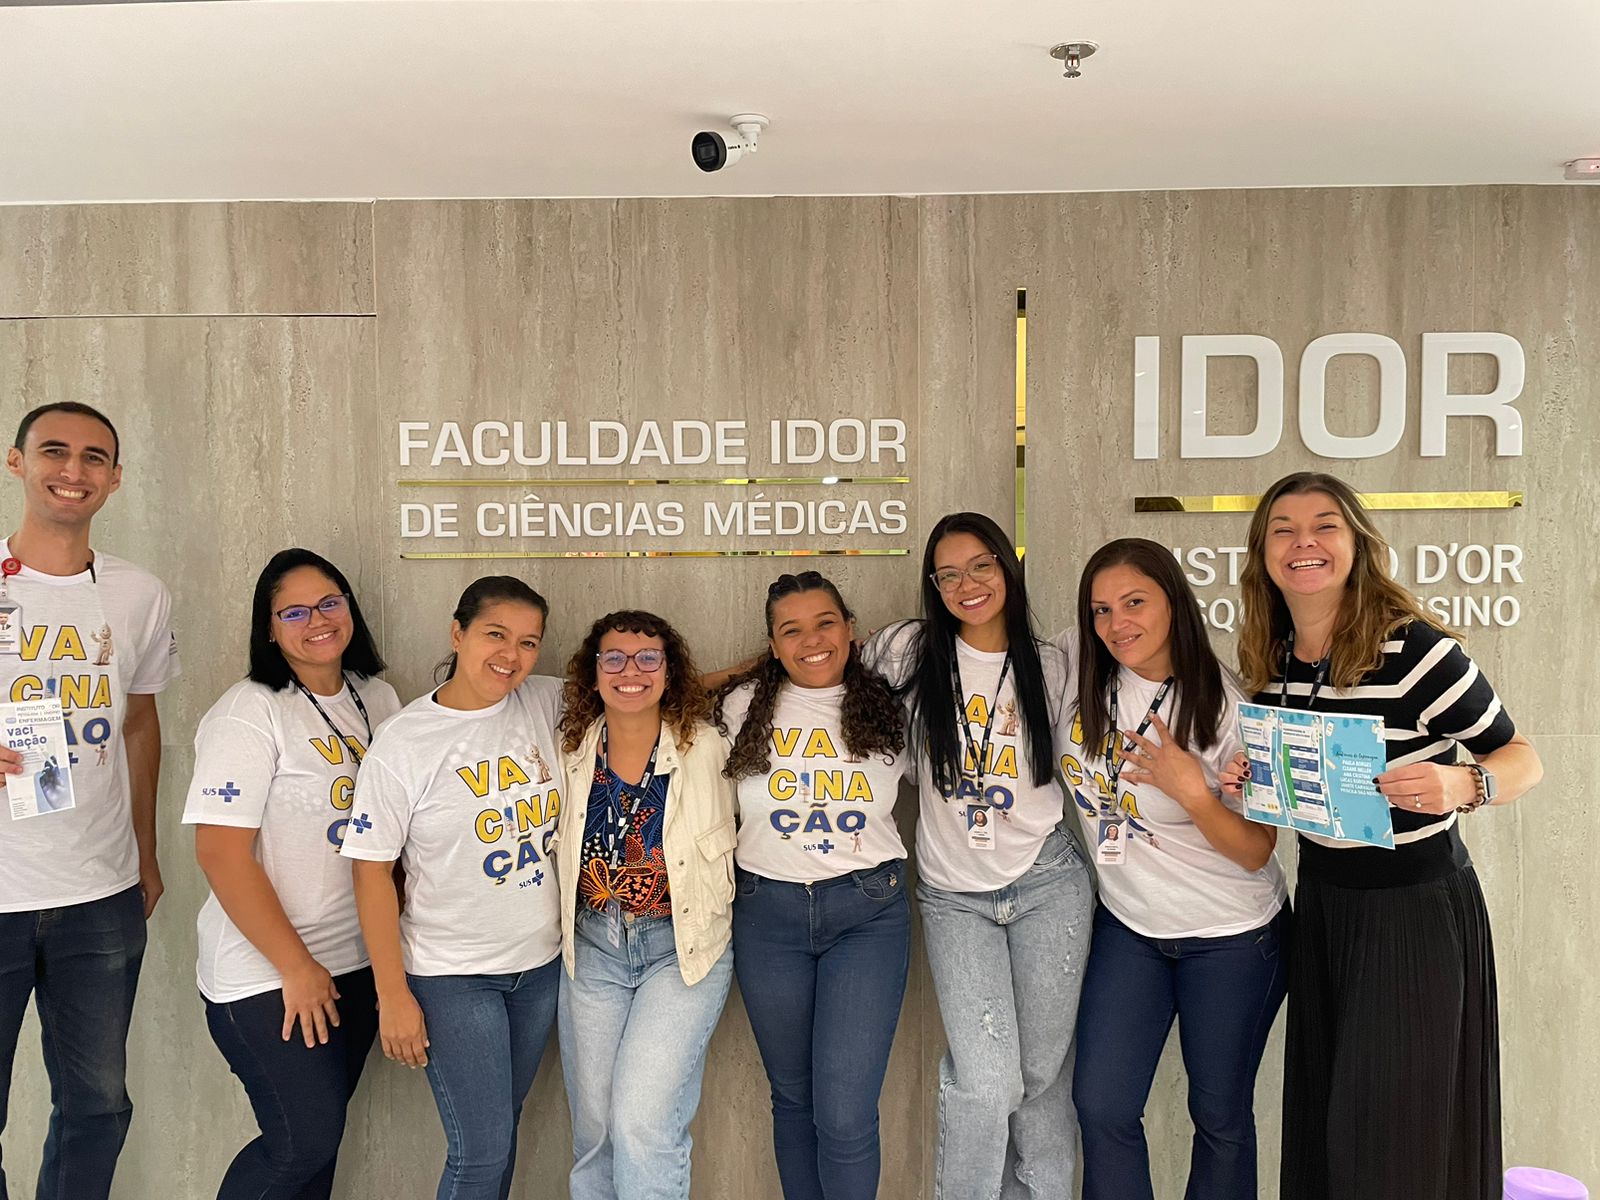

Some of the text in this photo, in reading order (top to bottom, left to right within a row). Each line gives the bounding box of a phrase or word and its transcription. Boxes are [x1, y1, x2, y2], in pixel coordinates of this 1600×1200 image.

[1133, 332, 1526, 459] IDOR
[399, 418, 907, 467] FACULDADE IDOR
[400, 491, 908, 538] DE CIÊNCIAS MÉDICAS
[1415, 542, 1524, 584] D'OR
[1417, 595, 1520, 627] SINO
[7, 726, 34, 737] vaci
[18, 715, 62, 724] ENFERMAGEM
[9, 734, 48, 750] nação
[771, 728, 839, 758] VA
[456, 755, 531, 798] VA
[769, 802, 867, 840] ÇÃO
[803, 843, 817, 852] SUS
[518, 878, 532, 890] SUS
